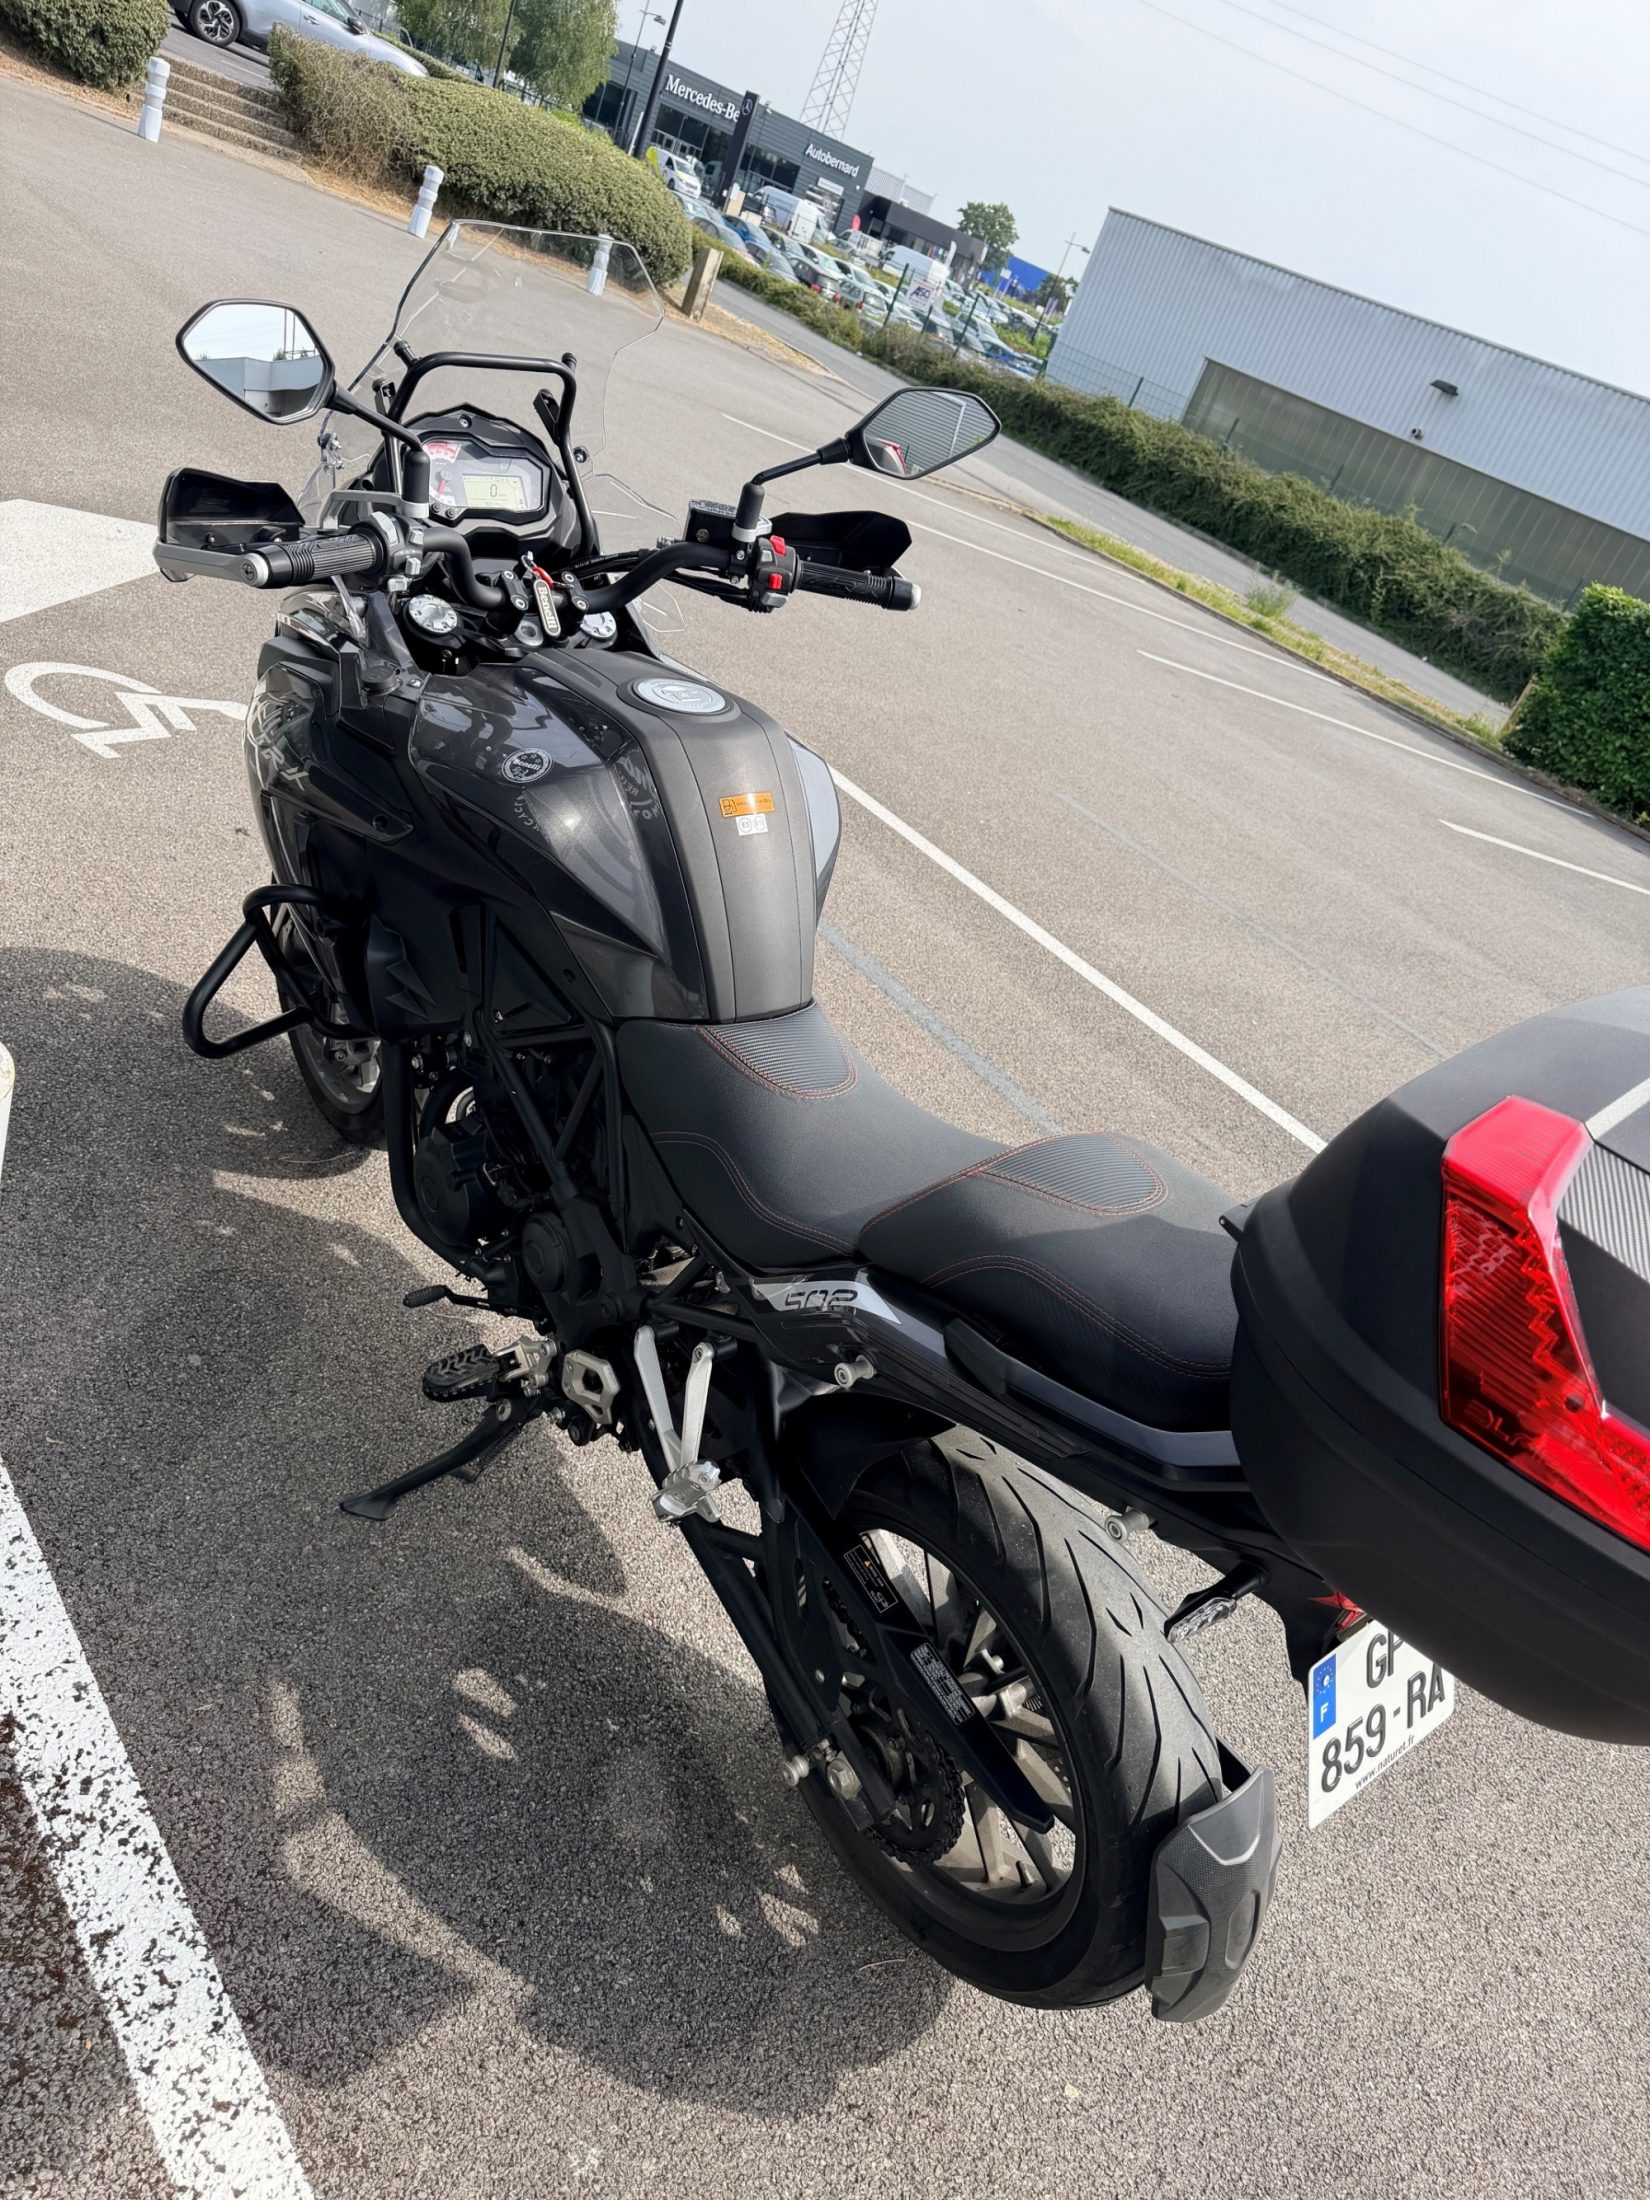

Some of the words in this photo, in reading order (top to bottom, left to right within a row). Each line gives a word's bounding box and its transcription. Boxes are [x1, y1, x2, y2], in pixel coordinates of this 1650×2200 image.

[665, 74, 740, 122] Mercedes-Be
[805, 143, 860, 177] Autobernard
[538, 586, 558, 629] Benelli
[513, 757, 542, 770] Benelli
[784, 1288, 858, 1315] 502
[1319, 1702, 1329, 1723] F
[1354, 1734, 1416, 1790] www.naturet.fr
